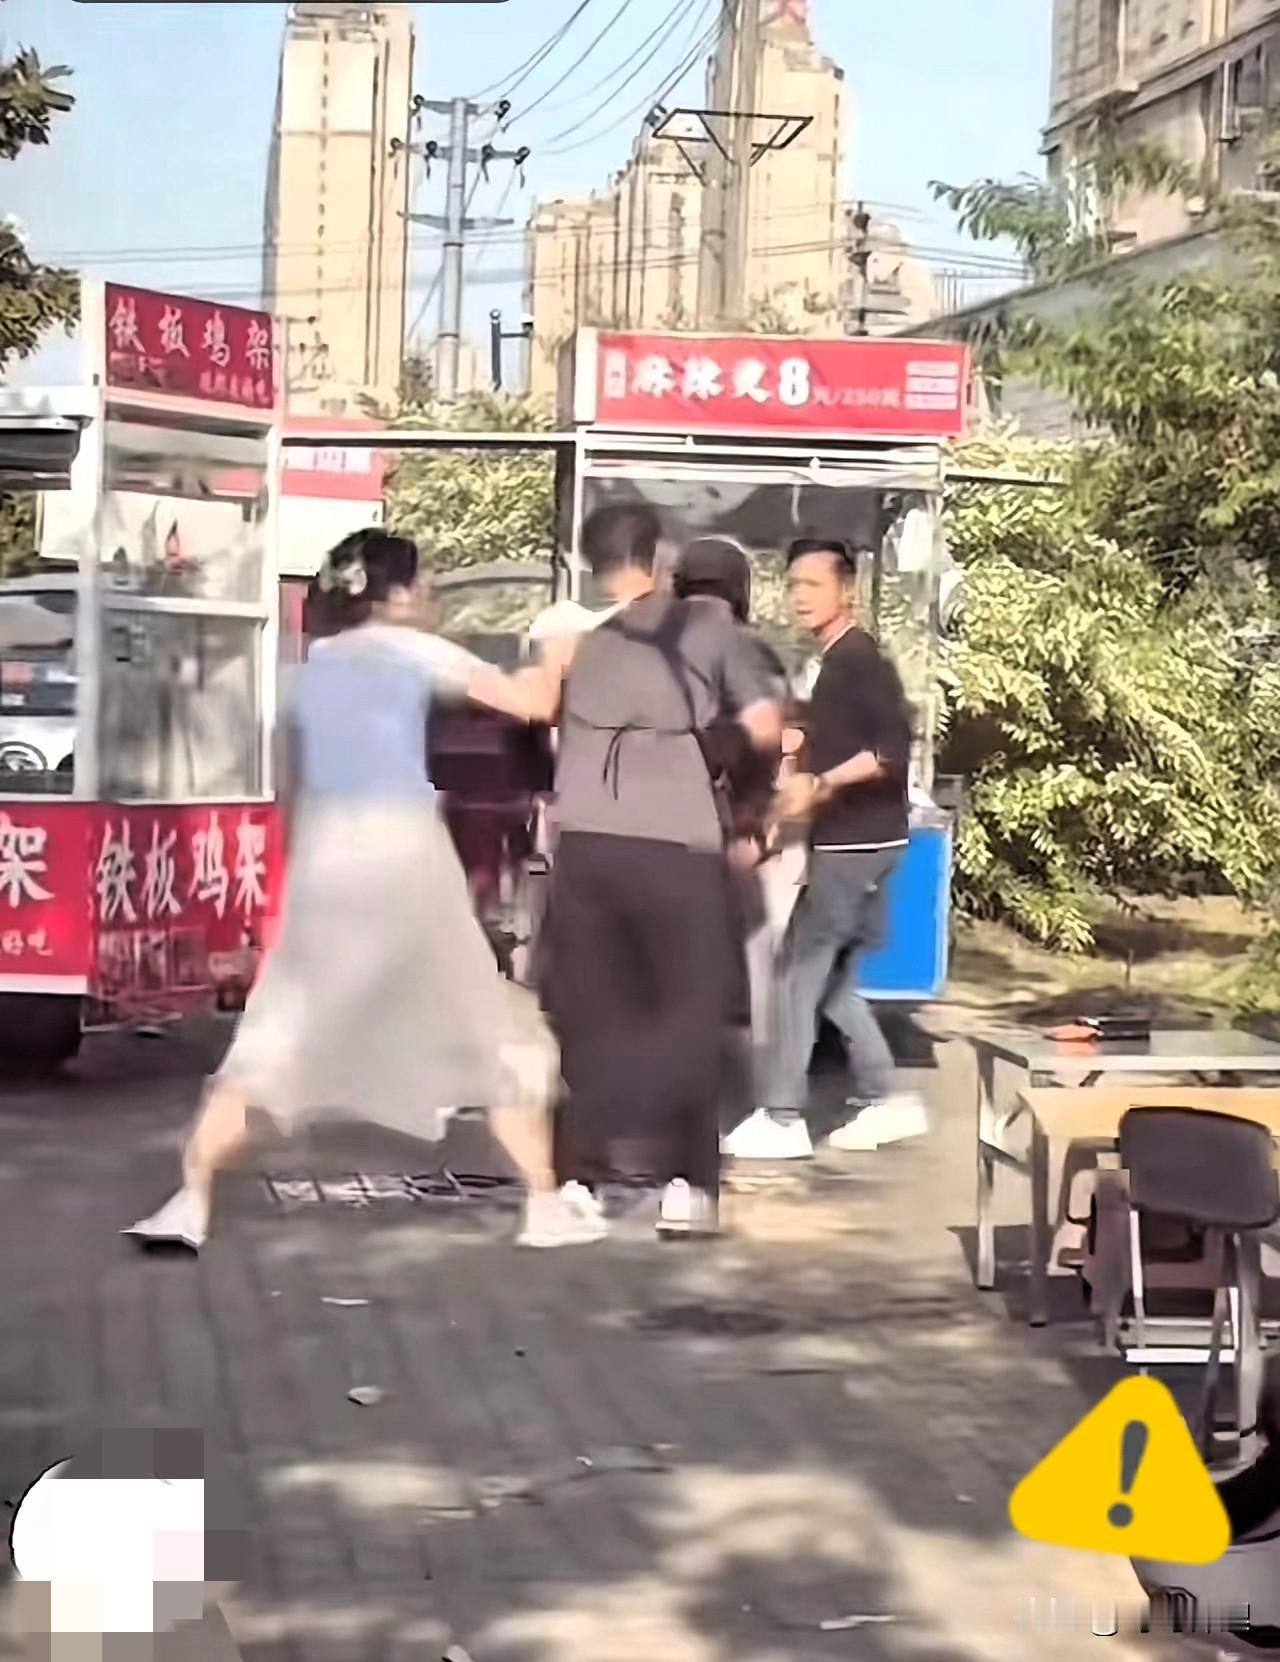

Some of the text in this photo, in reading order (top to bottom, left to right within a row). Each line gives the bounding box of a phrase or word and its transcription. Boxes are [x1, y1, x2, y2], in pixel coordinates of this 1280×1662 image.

[109, 297, 269, 370] 铁板鸡架
[96, 811, 268, 921] 铁板鸡架
